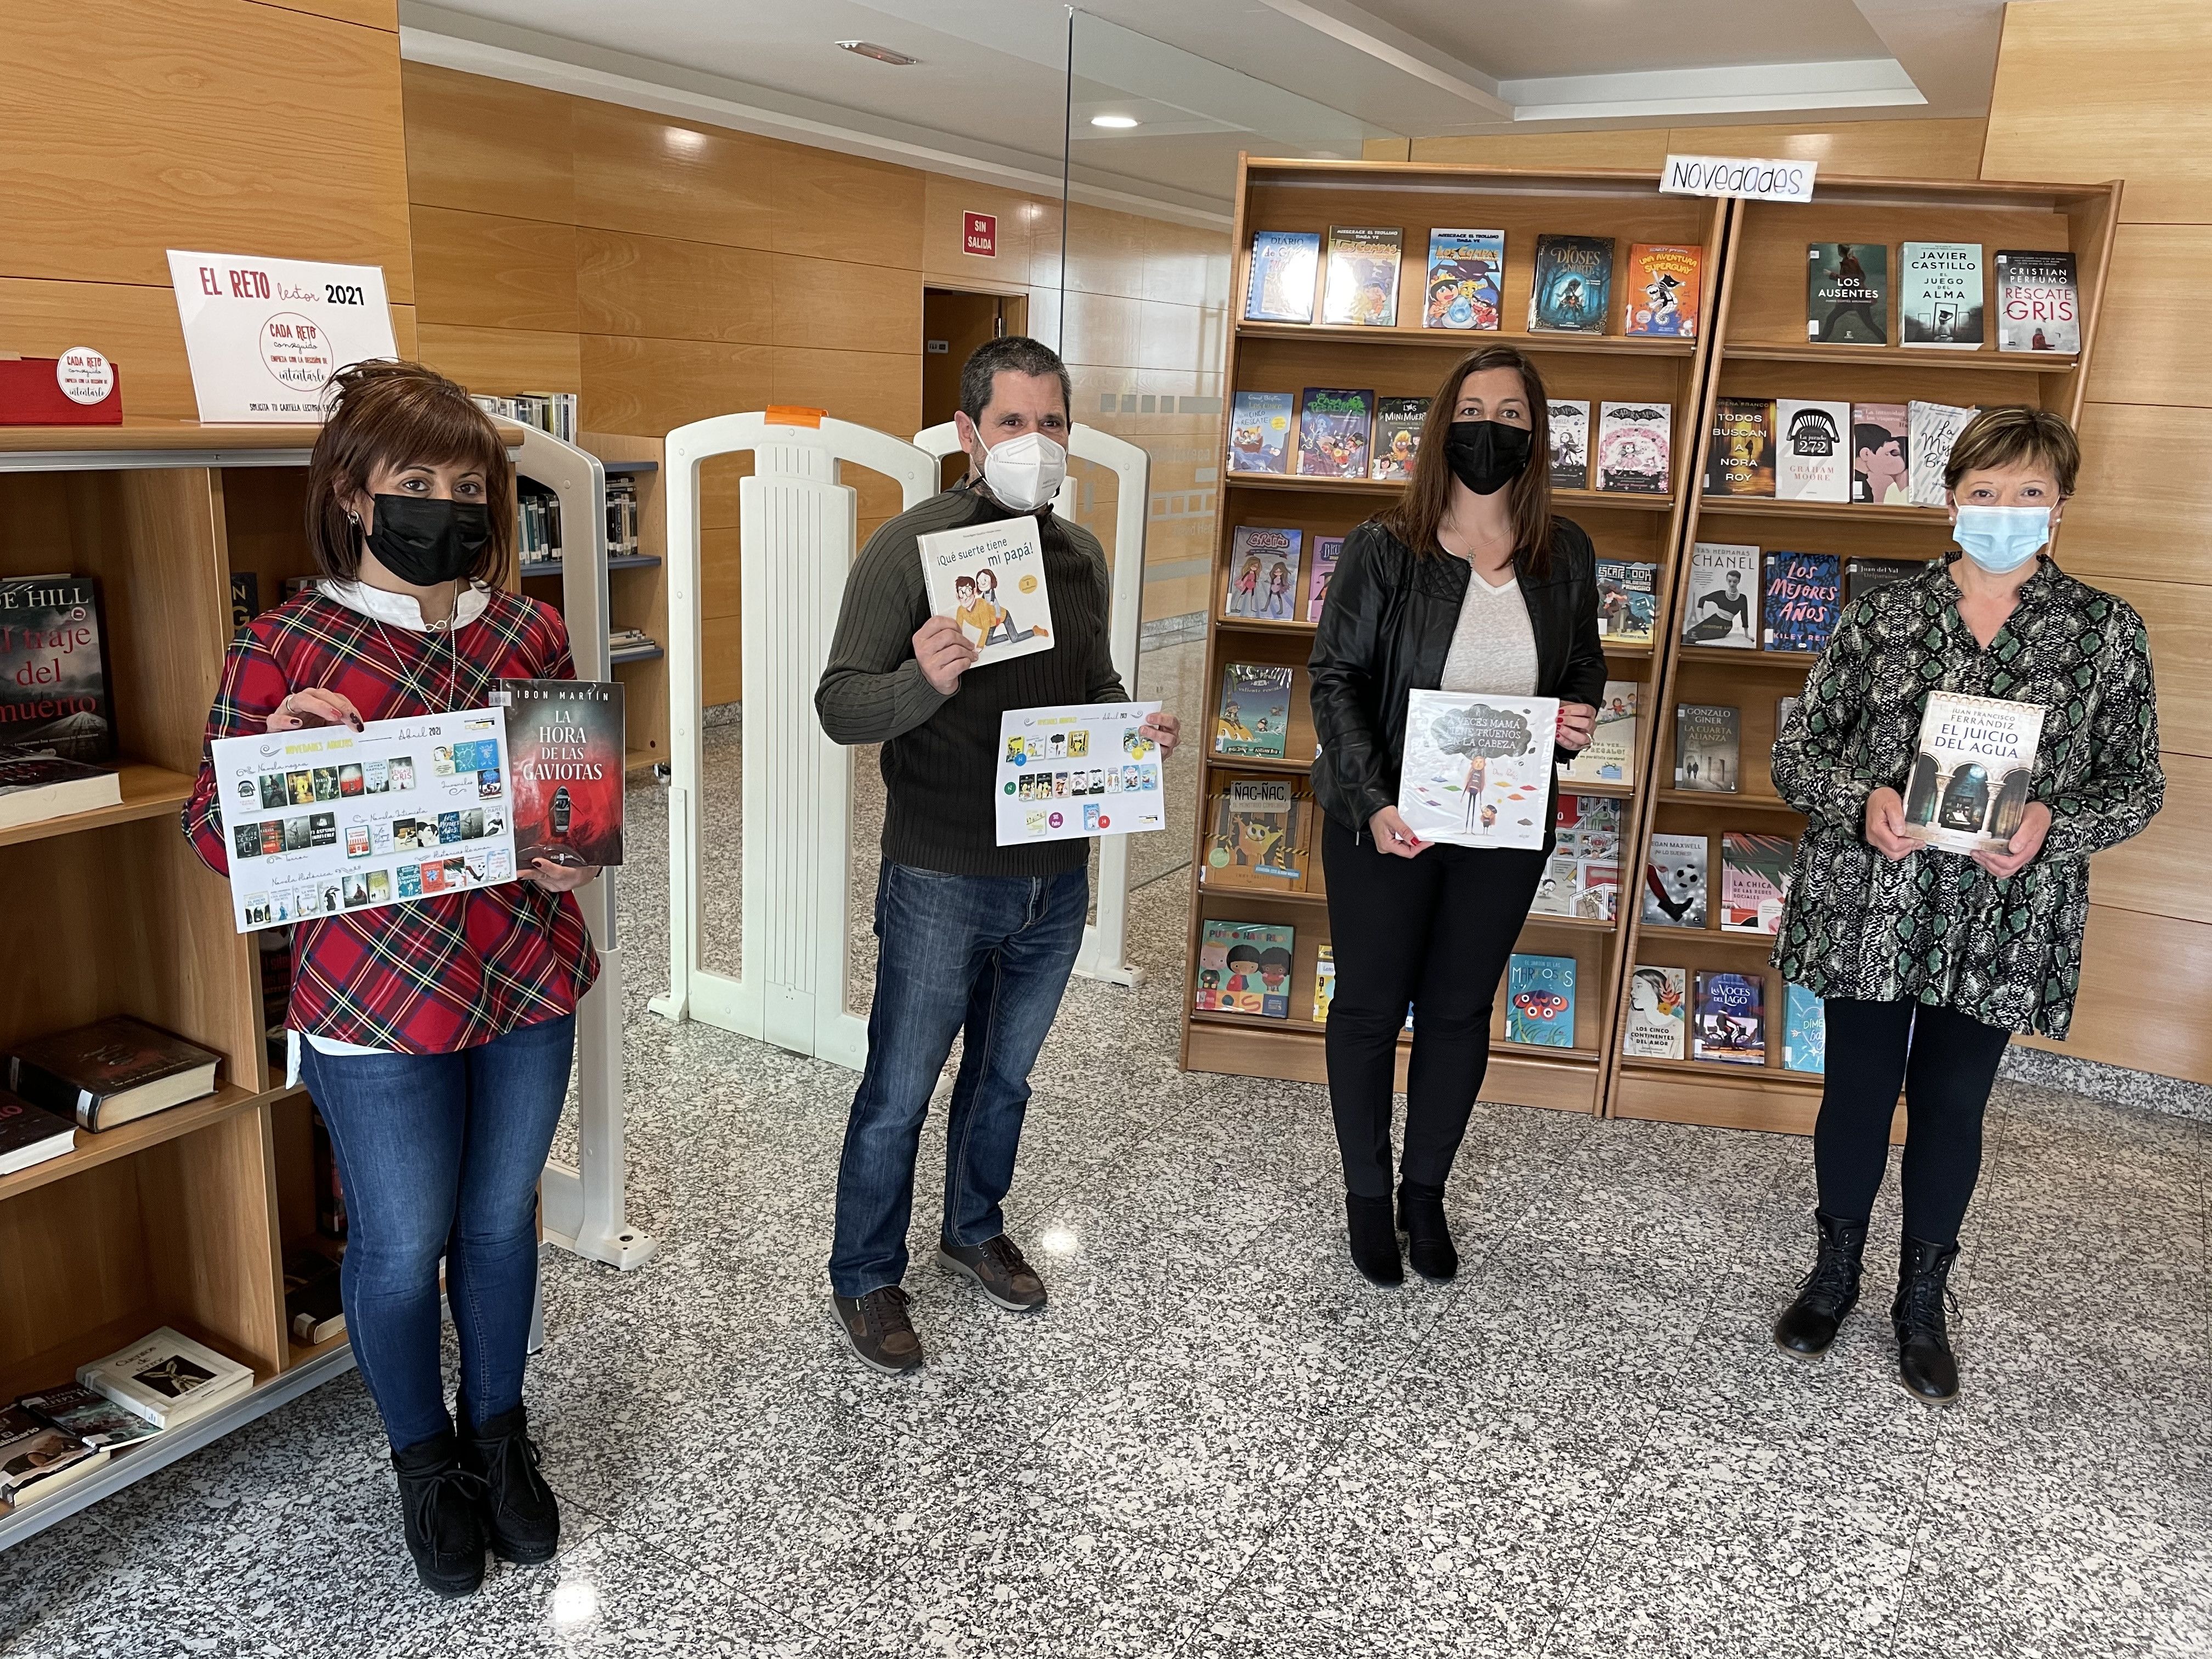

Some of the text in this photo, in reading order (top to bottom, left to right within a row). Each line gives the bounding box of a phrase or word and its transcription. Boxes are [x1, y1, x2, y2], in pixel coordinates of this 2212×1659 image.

[1673, 162, 1803, 194] Novedades
[974, 220, 986, 233] SIN
[968, 236, 992, 250] SALIDA
[1550, 247, 1600, 265] DIOSES
[1639, 254, 1697, 267] UNA AVENTURA
[1920, 251, 1967, 260] JAVIER
[1644, 262, 1693, 274] SUPERGUAY
[1911, 261, 1976, 270] CASTILLO
[2010, 267, 2067, 276] CRISTIAN
[199, 267, 364, 306] EL RETO lector 2021
[1838, 278, 1860, 287] LOS
[2010, 276, 2067, 284] PERFUMO
[1818, 289, 1878, 298] AUSENTES
[1922, 291, 1965, 299] ALMA
[2006, 287, 2072, 300] RESCATE
[2006, 301, 2073, 321] GRIS
[270, 323, 317, 341] CADA RETO
[273, 340, 318, 354] conseguido
[67, 356, 102, 368] CADA RETO
[279, 368, 327, 383] intentarlo
[69, 387, 104, 397] intentarlo
[249, 403, 269, 412] SOLICITA
[271, 403, 278, 411] TU
[280, 403, 301, 412] CARTILLA
[1718, 414, 1762, 422] TODOS
[1713, 428, 1767, 438] BUSCAN
[1938, 421, 1955, 437] La
[1735, 444, 1743, 452] A
[1799, 441, 1826, 454] 272
[1720, 458, 1758, 467] NORA
[1790, 465, 1834, 473] GRAHAM
[1725, 473, 1752, 482] ROY
[1794, 473, 1831, 481] MOORE
[937, 538, 1007, 566] ¡Qué suerte tiene
[988, 542, 1034, 567] mi papá!
[1692, 554, 1755, 570] CHANEL
[1598, 565, 1625, 579] ESCAPE
[1786, 561, 1818, 580] LOS
[1768, 578, 1838, 601] MEJORES
[27, 588, 89, 607] HILL
[1779, 601, 1827, 622] AÑOS
[22, 627, 92, 654] traje
[16, 658, 61, 686] del
[517, 690, 610, 702] IBON MARTÍN
[555, 710, 571, 724] LA
[1687, 708, 1731, 718] GONZALO
[1952, 708, 2016, 722] JUAN FRANCISCO
[1489, 718, 1521, 729] MAMÁ
[1695, 716, 1722, 725] GINER
[1950, 714, 2015, 730] FERRÁNDIZ
[428, 726, 441, 736] 2021
[539, 726, 587, 744] HORA
[1476, 729, 1521, 740] TRUENOS
[1696, 726, 1733, 735] CUARTA
[1942, 724, 2018, 744] EL JUICIO
[1462, 738, 1516, 749] LA CABEZA
[1689, 733, 1726, 742] ALIANZA
[541, 747, 584, 760] DE LAS
[1934, 736, 2018, 759] DEL AGUA
[522, 763, 603, 780] GAVIOTAS
[1234, 782, 1287, 803] ÑAC-ÑAC,
[1719, 984, 1751, 996] VOCES
[1724, 994, 1748, 1007] LAGO
[1630, 1032, 1674, 1040] CONTINENTES
